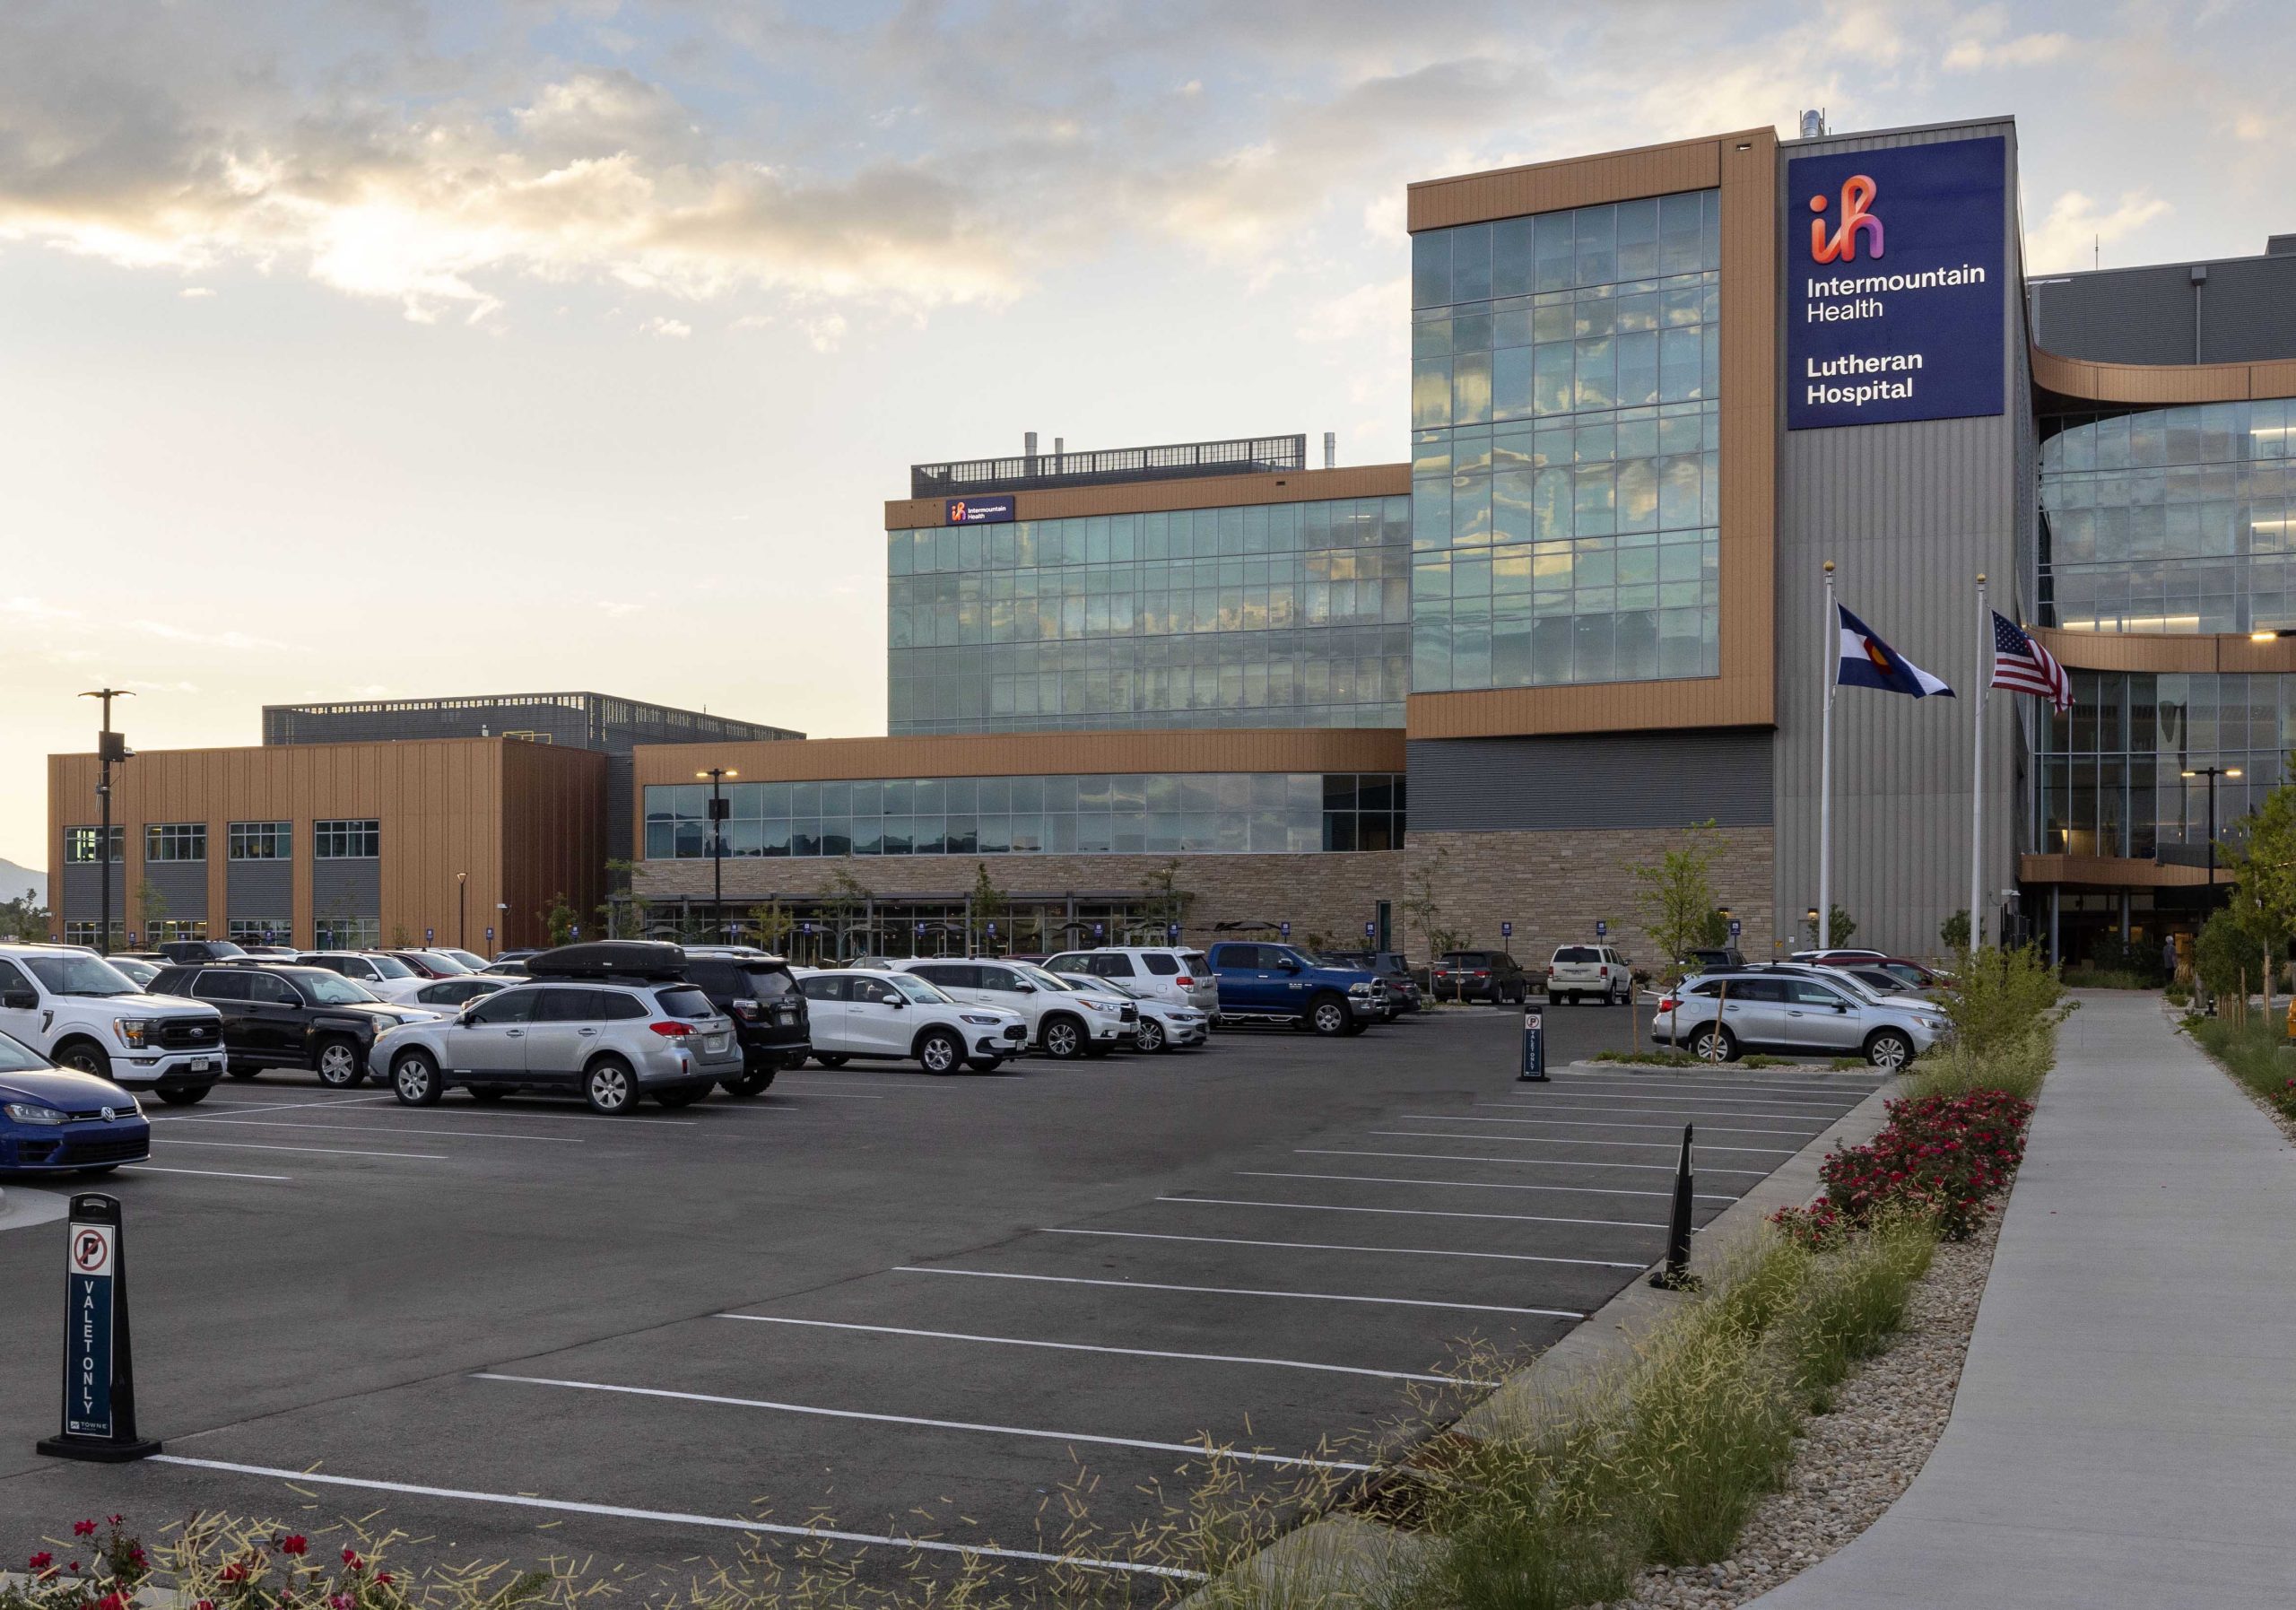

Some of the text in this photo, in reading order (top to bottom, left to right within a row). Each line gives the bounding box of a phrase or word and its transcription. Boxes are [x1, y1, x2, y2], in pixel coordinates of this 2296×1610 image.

[1807, 264, 1986, 298] Intermountain
[1807, 298, 1883, 323] Health
[1807, 353, 1923, 378] Lutheran
[1807, 378, 1913, 405] Hospital
[968, 506, 1006, 514] Intermountain
[83, 1281, 94, 1353] VALET
[83, 1357, 94, 1414] ONLY
